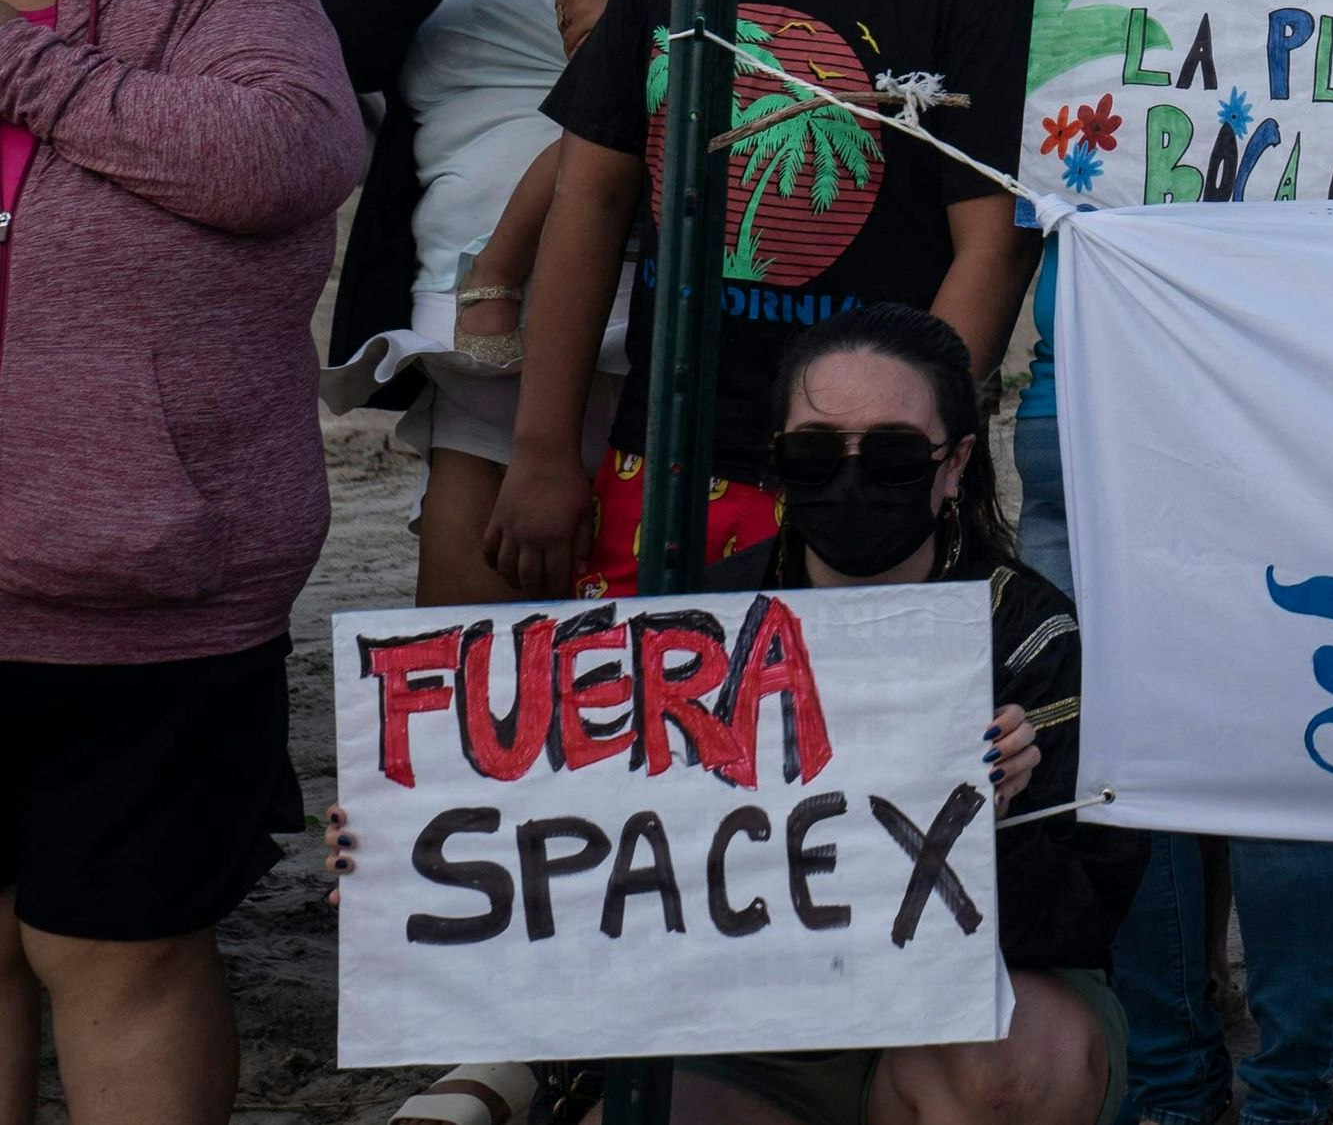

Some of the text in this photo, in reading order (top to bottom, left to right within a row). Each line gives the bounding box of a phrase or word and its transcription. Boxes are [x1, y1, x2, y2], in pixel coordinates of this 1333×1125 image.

[1122, 8, 1218, 90] LA
[1144, 104, 1301, 204] BOCA
[357, 593, 833, 790] FUERA
